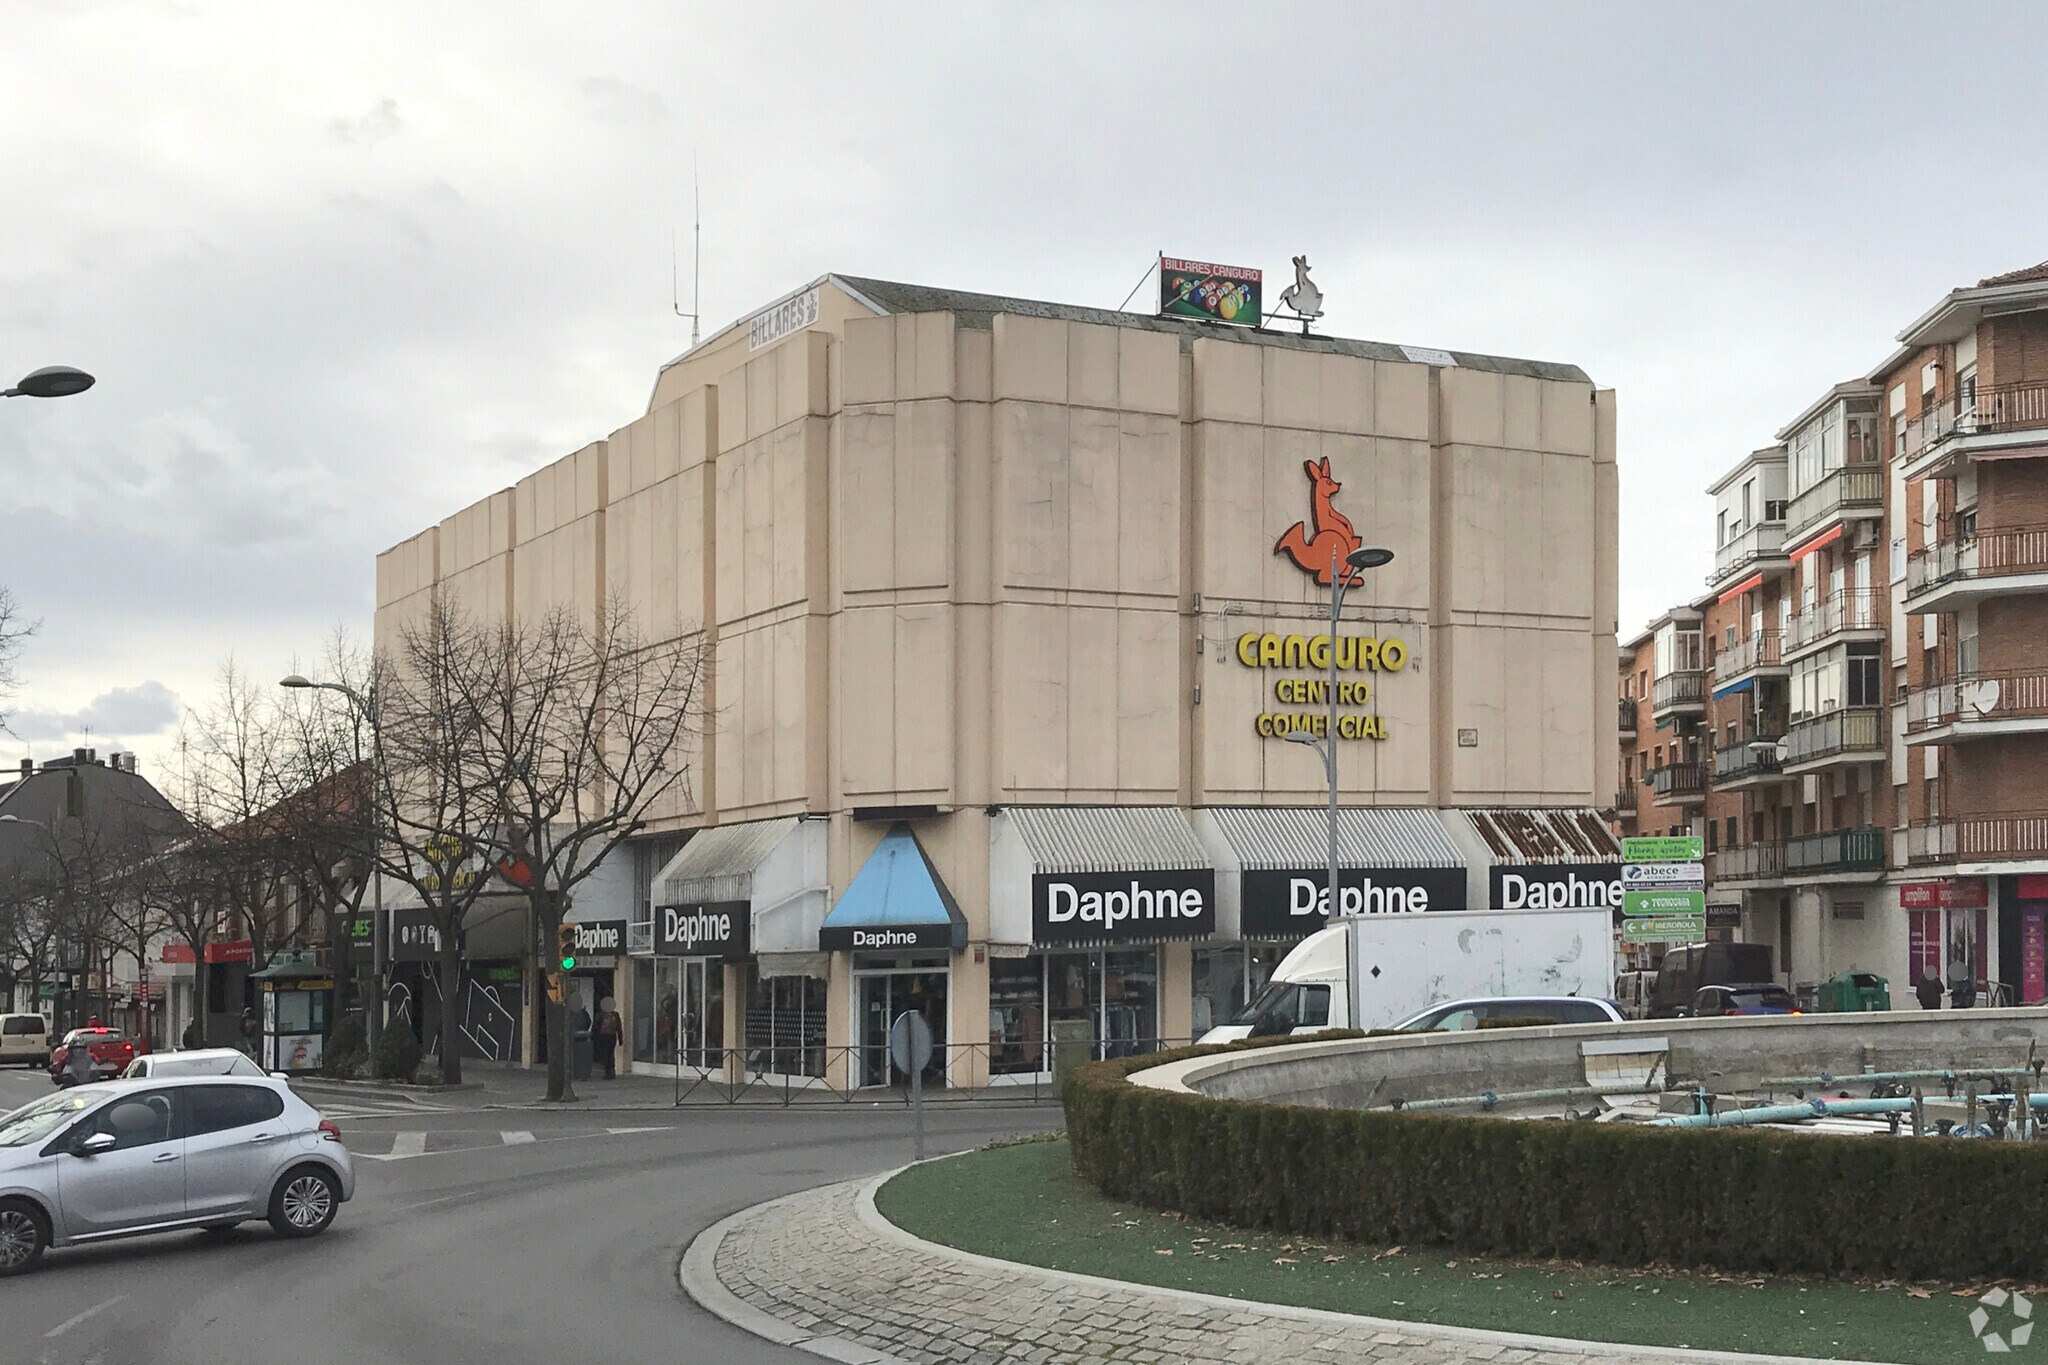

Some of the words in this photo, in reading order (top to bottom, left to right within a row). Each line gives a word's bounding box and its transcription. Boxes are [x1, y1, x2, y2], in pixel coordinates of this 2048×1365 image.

[1165, 258, 1211, 274] BILLARES
[1212, 266, 1259, 281] CANGURO
[750, 296, 805, 349] BILLARES
[1237, 632, 1408, 672] CANGURO
[1276, 678, 1370, 705] CENTRO
[1643, 866, 1679, 875] abece
[1048, 881, 1202, 929] Daphne
[1290, 878, 1428, 915] Daphne
[1502, 873, 1623, 909] Daphne
[575, 923, 619, 954] Daphne
[665, 907, 731, 949] Daphne
[853, 930, 917, 949] Daphne
